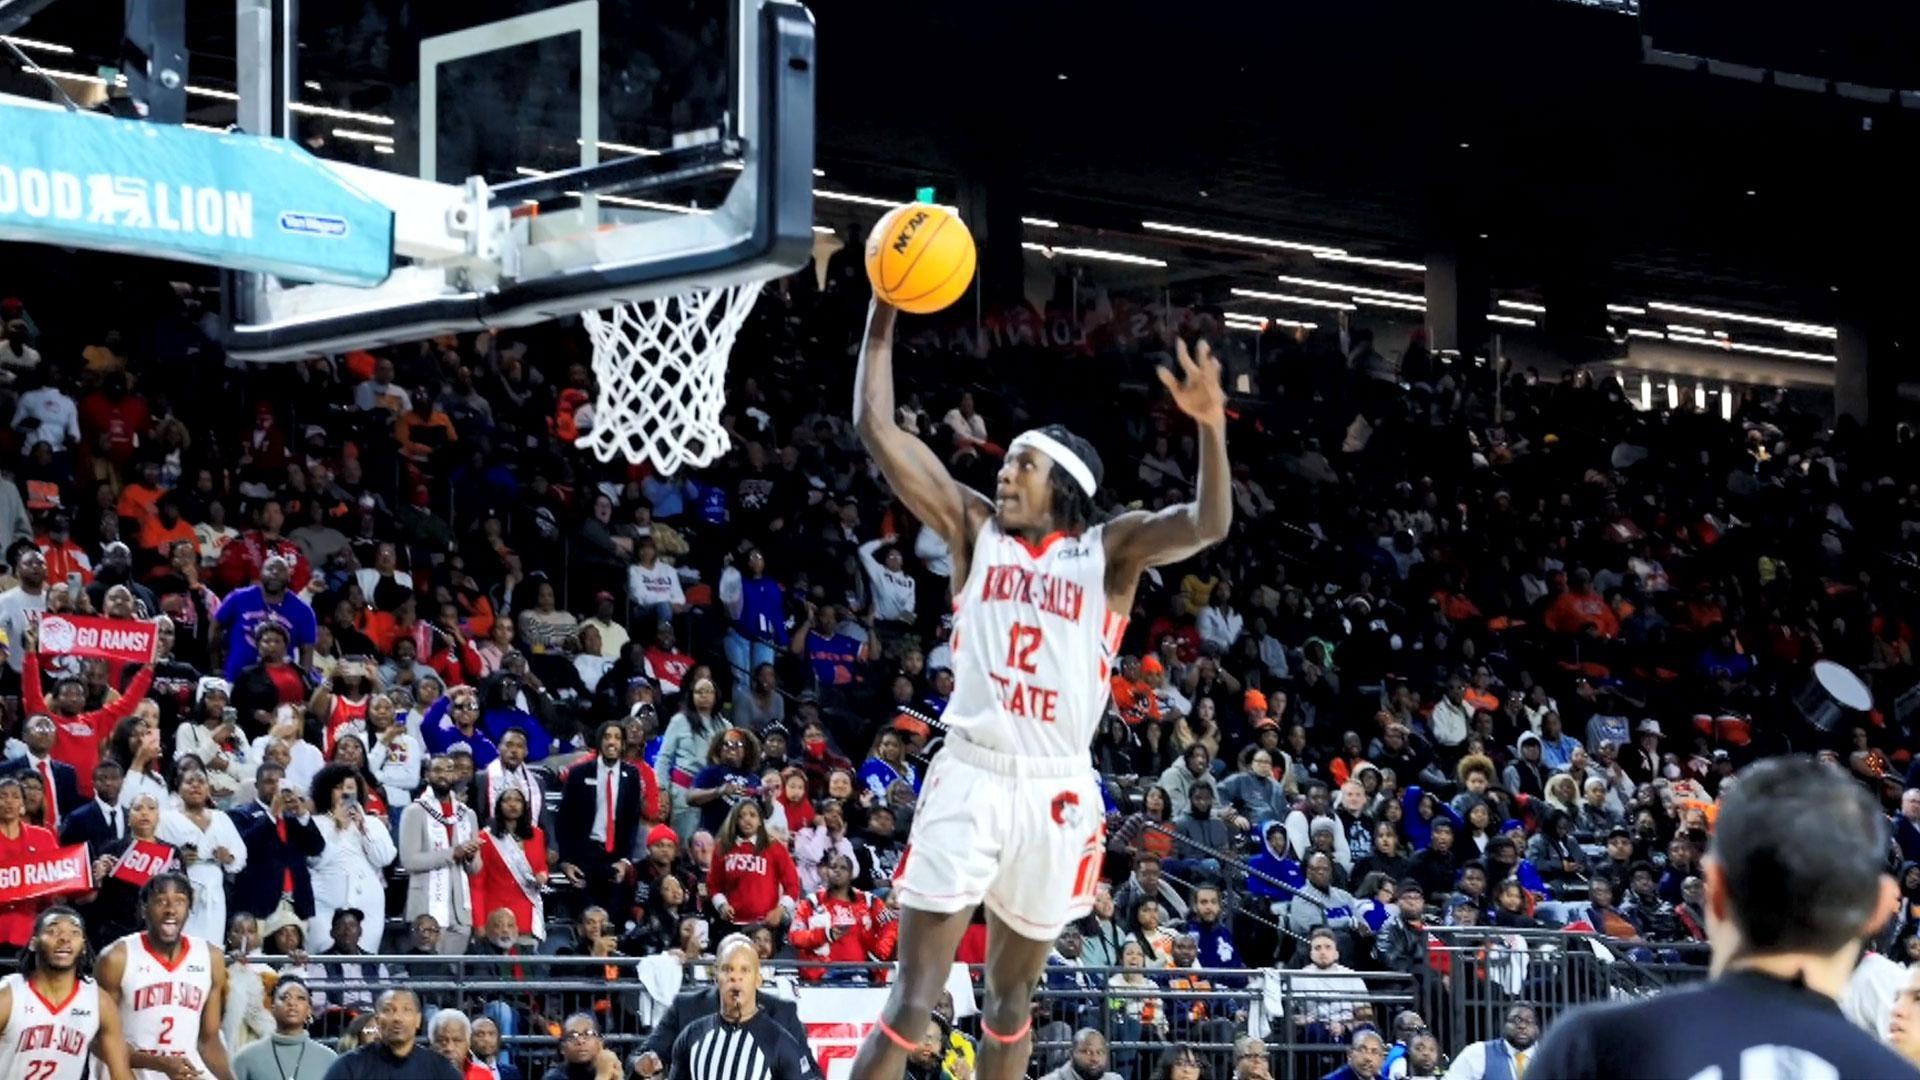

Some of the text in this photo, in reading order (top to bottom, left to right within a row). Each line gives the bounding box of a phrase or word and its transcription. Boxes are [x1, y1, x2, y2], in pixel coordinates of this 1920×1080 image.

[154, 182, 253, 238] LION
[893, 211, 928, 254] NCAA
[77, 627, 150, 652] GO RAMS!
[1006, 622, 1041, 674] 12
[990, 672, 1058, 722] TATE
[0, 858, 81, 888] GO RAMS!
[124, 849, 151, 872] GO
[725, 853, 767, 876] WSSU
[158, 1016, 174, 1044] 2
[24, 1060, 58, 1080] 22
